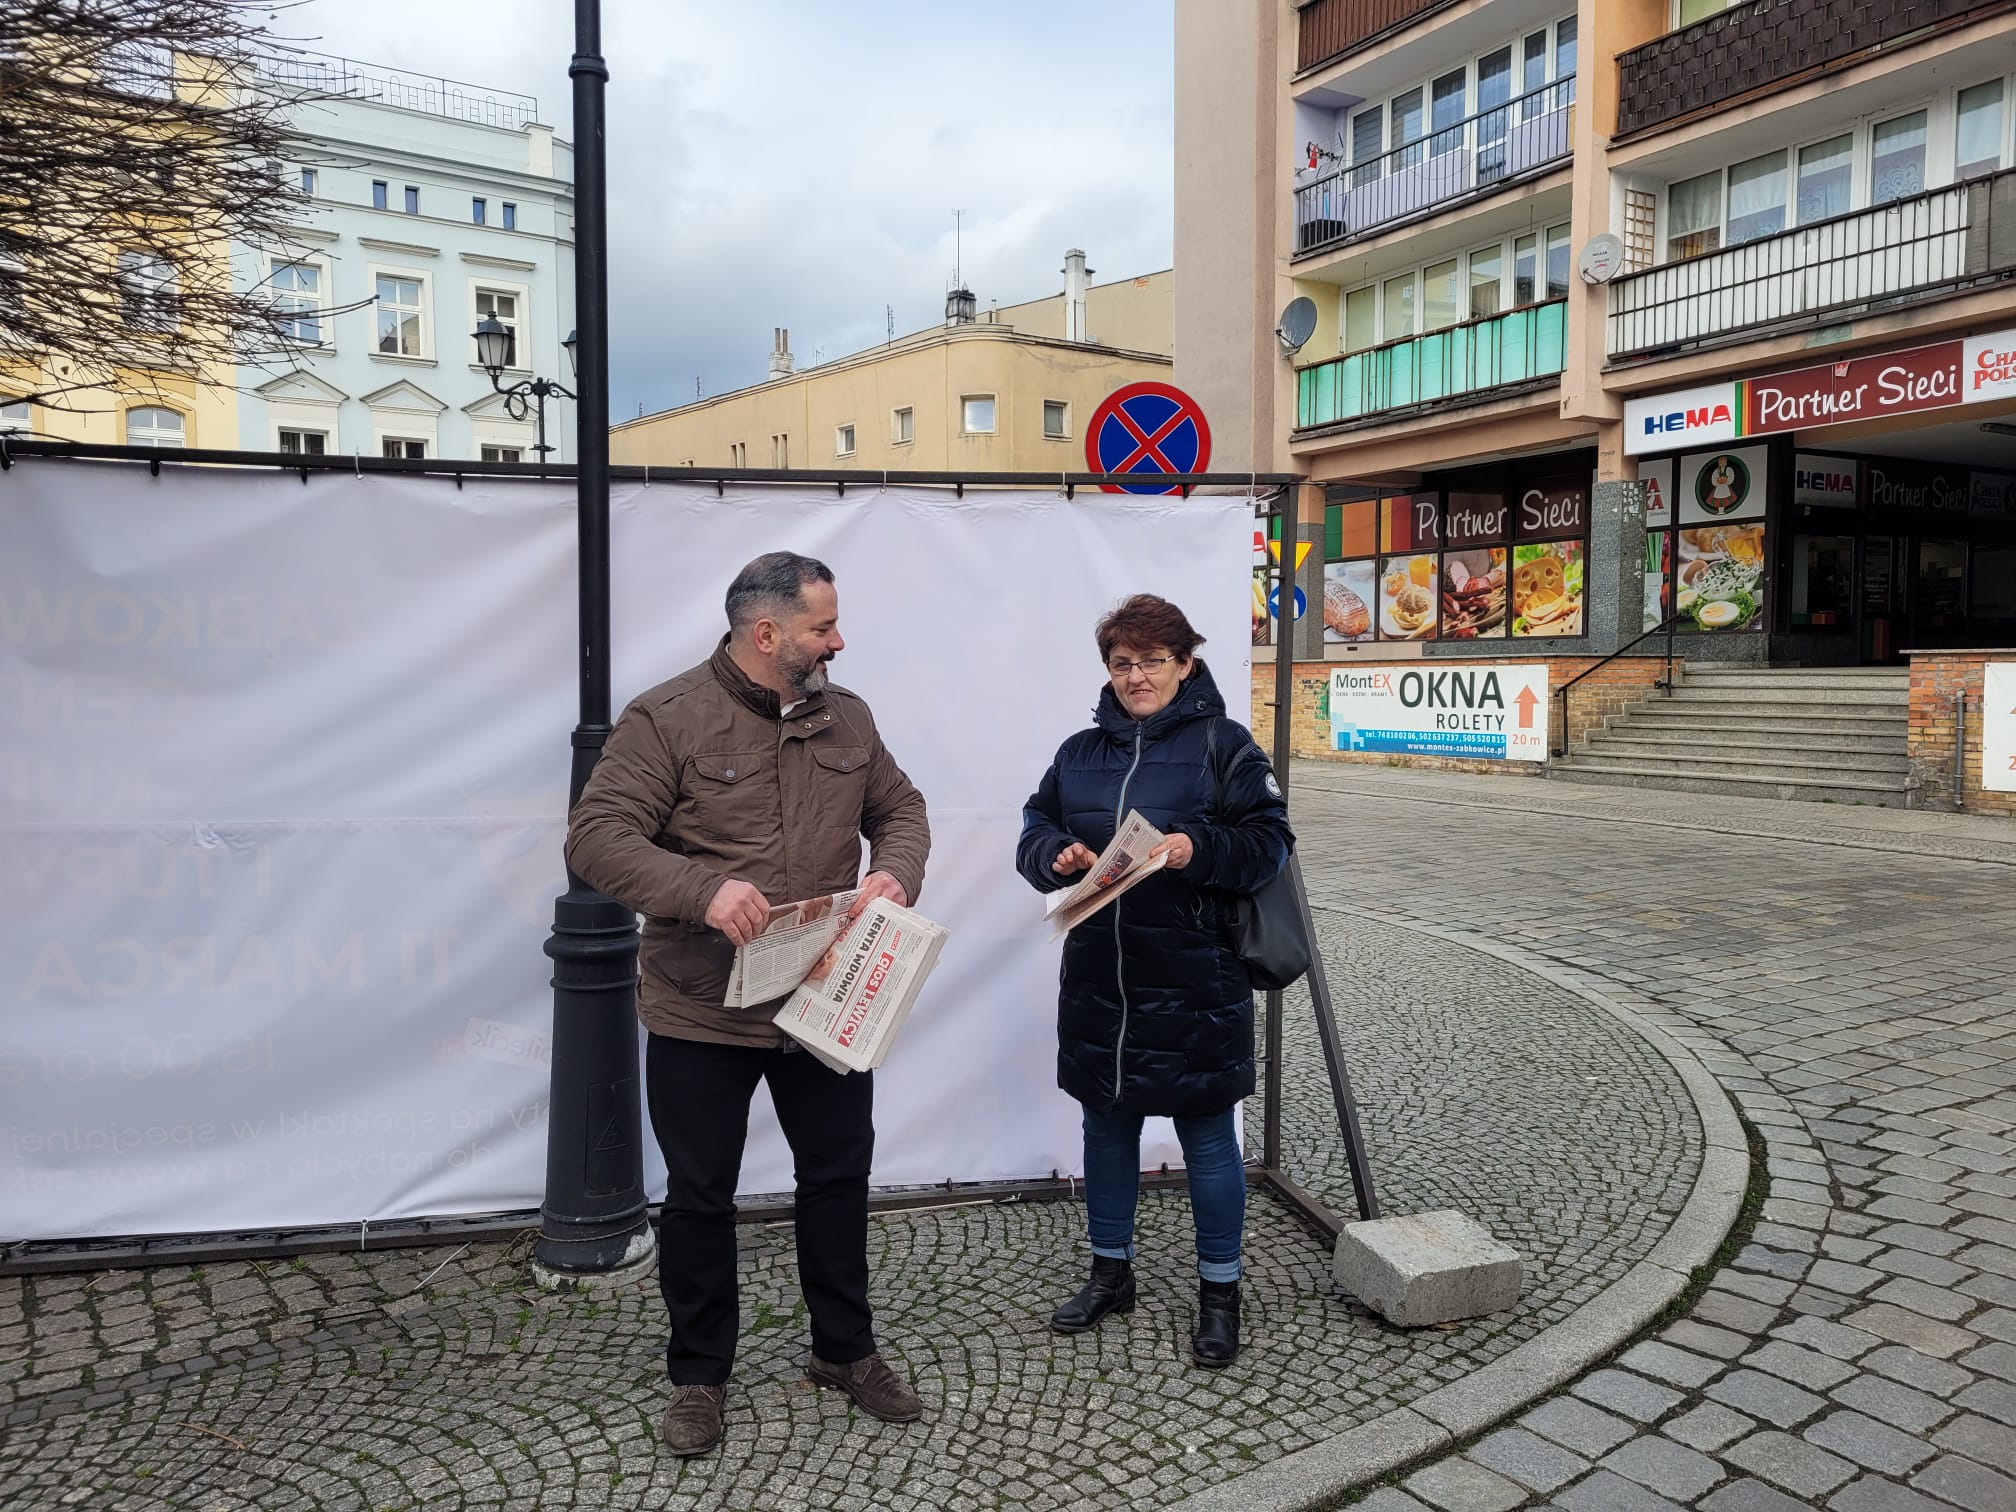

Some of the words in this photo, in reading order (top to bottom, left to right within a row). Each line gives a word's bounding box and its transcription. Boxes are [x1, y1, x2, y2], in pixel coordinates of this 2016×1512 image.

[1756, 382, 1868, 425] Partner
[1878, 364, 1957, 405] Sieci
[1644, 403, 1732, 435] HEMA
[1797, 470, 1854, 493] HEMA
[1870, 468, 1928, 507] Partner
[1931, 474, 1968, 511] Sieci
[1415, 501, 1507, 541] Partner
[1522, 489, 1581, 530] Sieci
[1336, 673, 1394, 696] MontEX
[1399, 671, 1505, 709] OKNA
[1365, 731, 1377, 739] tel.
[1436, 713, 1505, 731] ROLETY
[1512, 734, 1527, 745] 20
[1530, 735, 1541, 745] m
[1407, 743, 1505, 756] www.montex-zabkowice.pl
[859, 913, 886, 953] RENTA
[832, 952, 864, 1003] WDOWIA
[841, 987, 873, 1043] LEWICY
